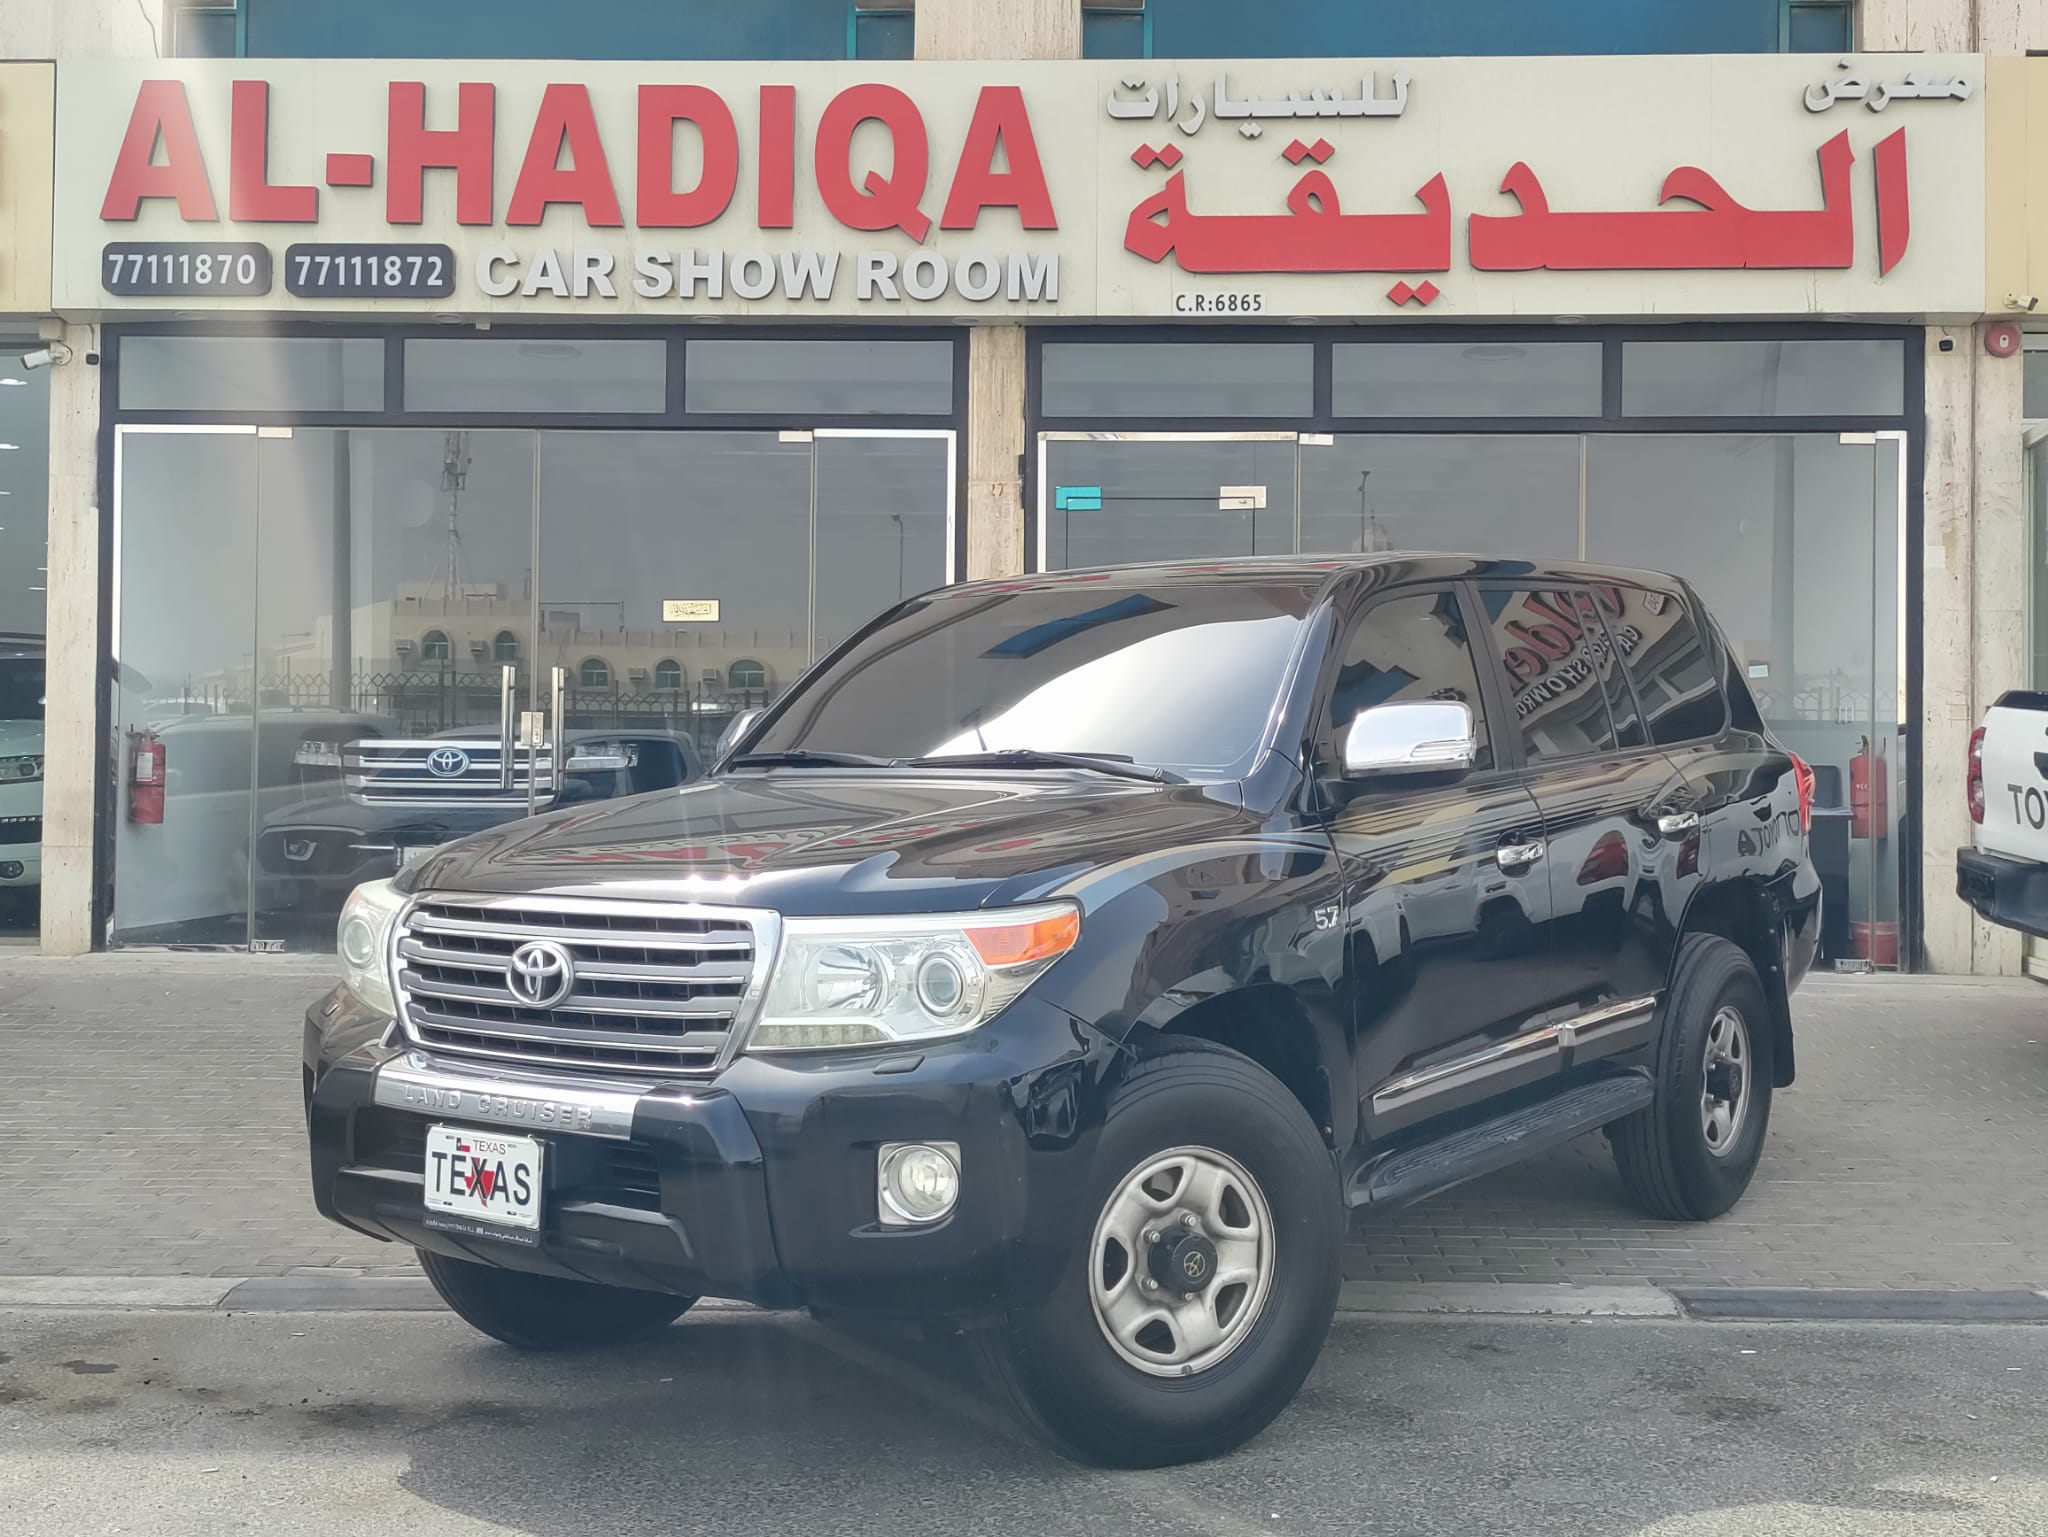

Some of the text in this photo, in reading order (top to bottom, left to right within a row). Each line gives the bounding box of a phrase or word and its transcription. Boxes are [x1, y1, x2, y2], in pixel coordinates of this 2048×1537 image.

[1107, 68, 1413, 139] للسيارات
[1804, 58, 1974, 114] معرض
[99, 79, 1058, 245] AL-HADIQA
[1123, 125, 1911, 307] الحديقة
[108, 254, 256, 285] 77111870
[295, 256, 443, 287] 77111872
[475, 248, 1060, 303] CAR SHOW ROOM
[1176, 294, 1262, 312] C.R:6865
[2007, 783, 2048, 830] TO
[403, 1085, 593, 1129] LAND CRUISER
[473, 1139, 505, 1155] TEXAS
[432, 1151, 531, 1206] TEXAS
